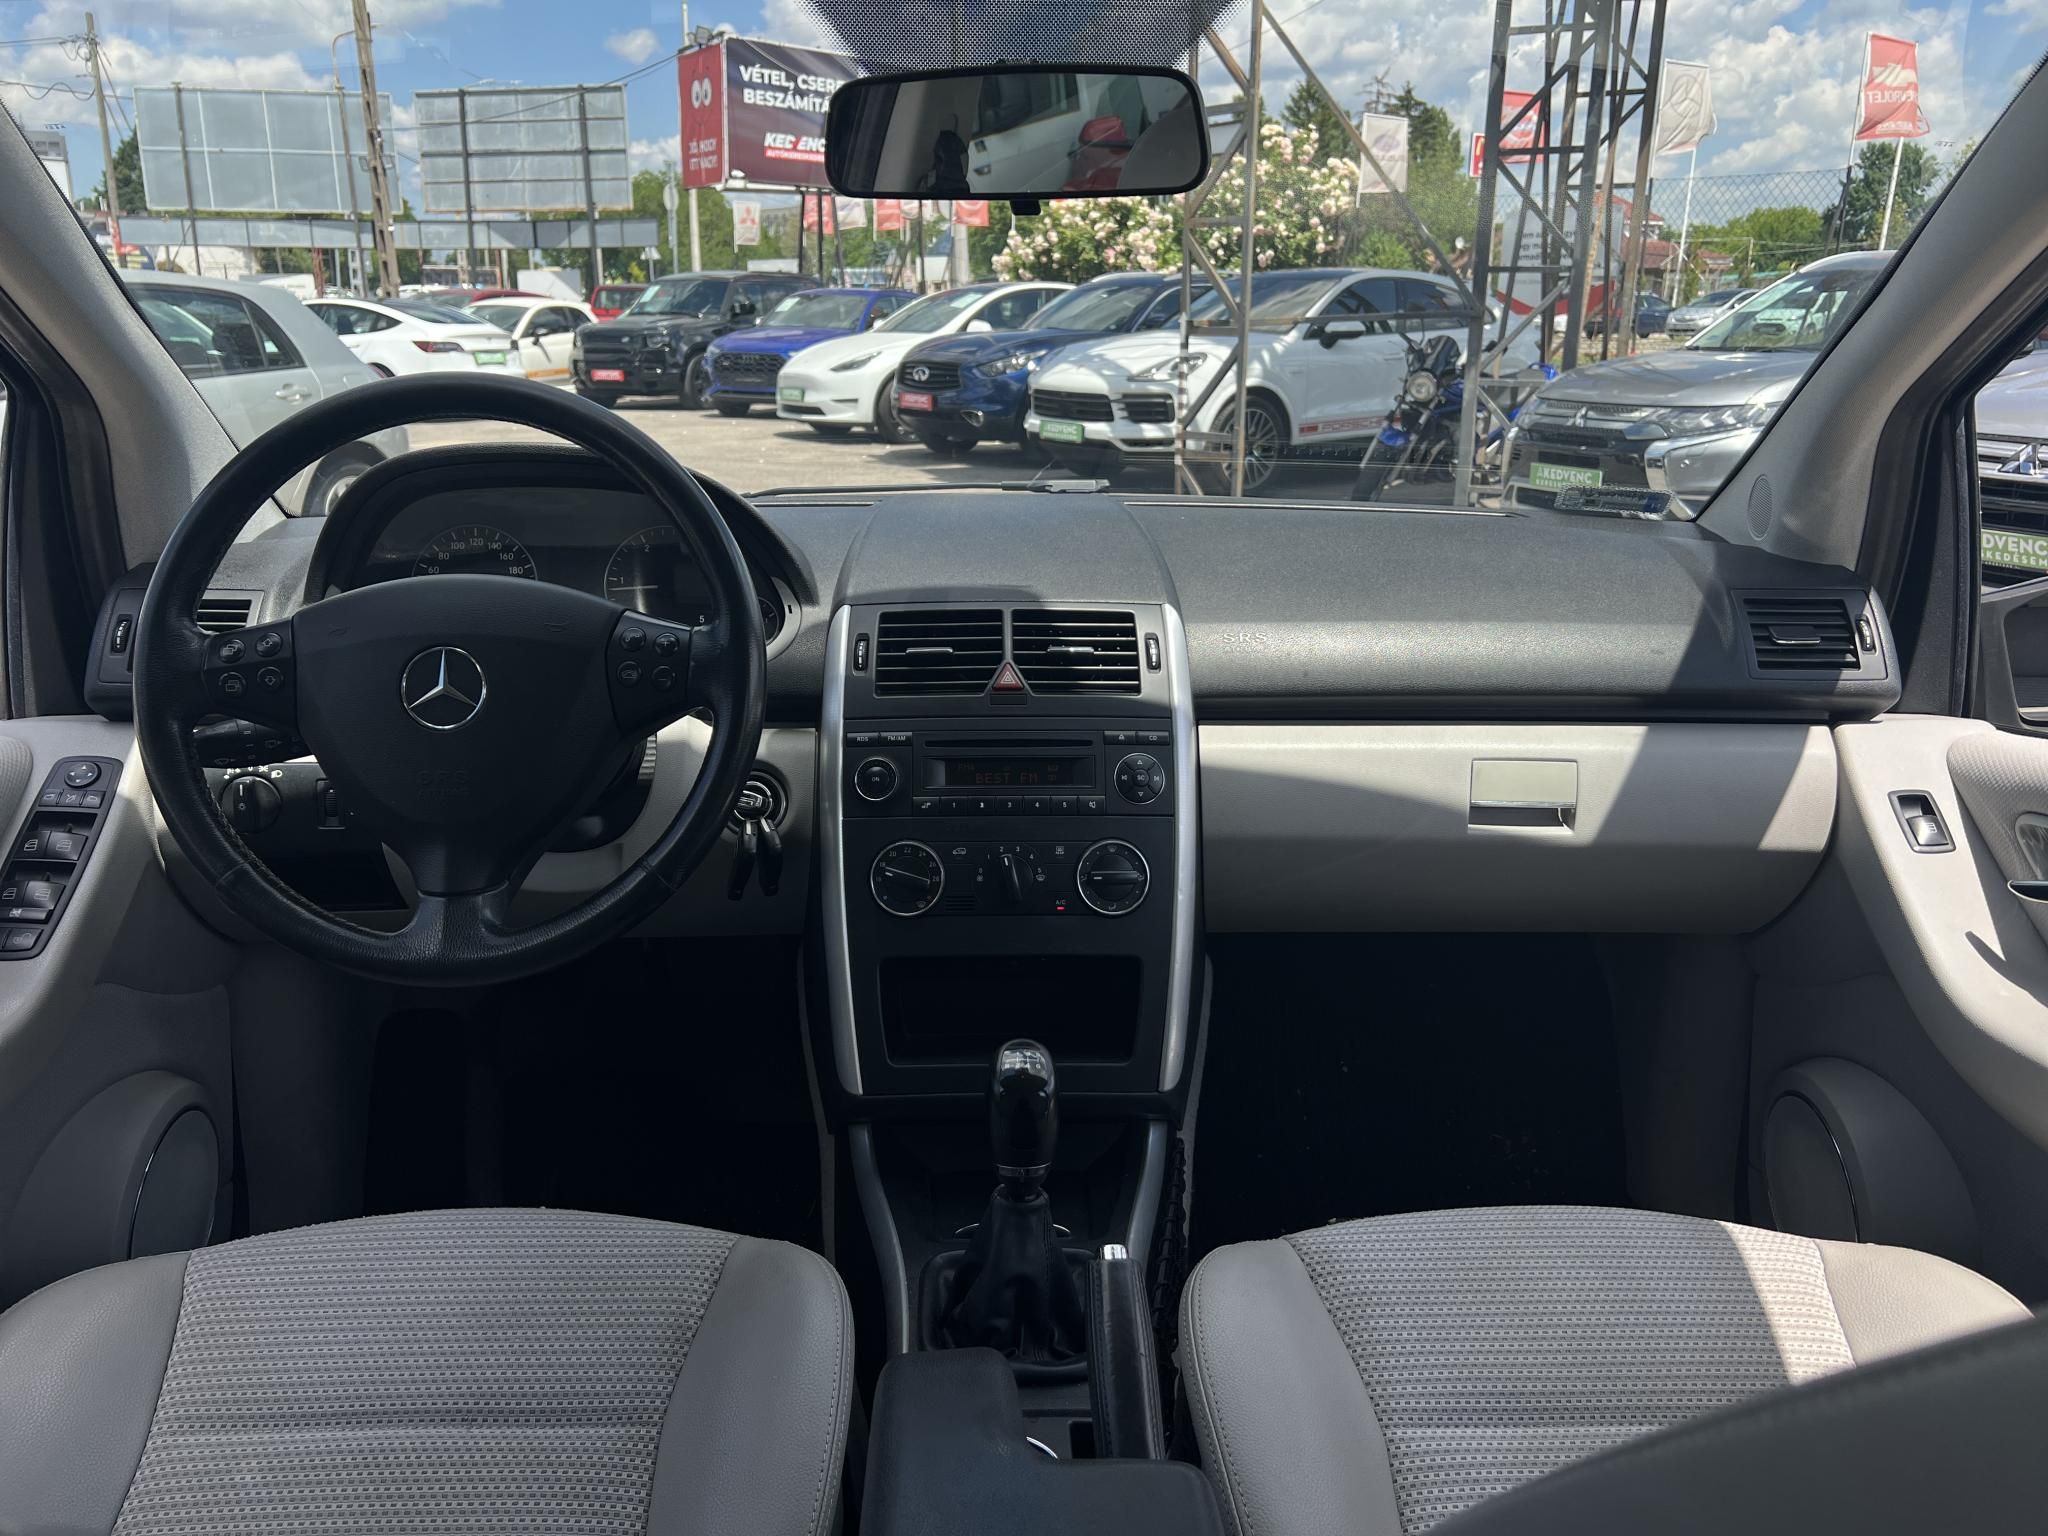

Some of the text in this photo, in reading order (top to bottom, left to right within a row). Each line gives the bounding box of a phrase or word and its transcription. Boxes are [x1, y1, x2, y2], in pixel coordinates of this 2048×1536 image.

[739, 64, 795, 90] VÉTEL,
[470, 537, 484, 546] 120
[451, 542, 465, 550] 100
[488, 542, 502, 550] 140
[428, 566, 440, 574] 60
[509, 566, 524, 574] 180
[699, 615, 705, 623] 5
